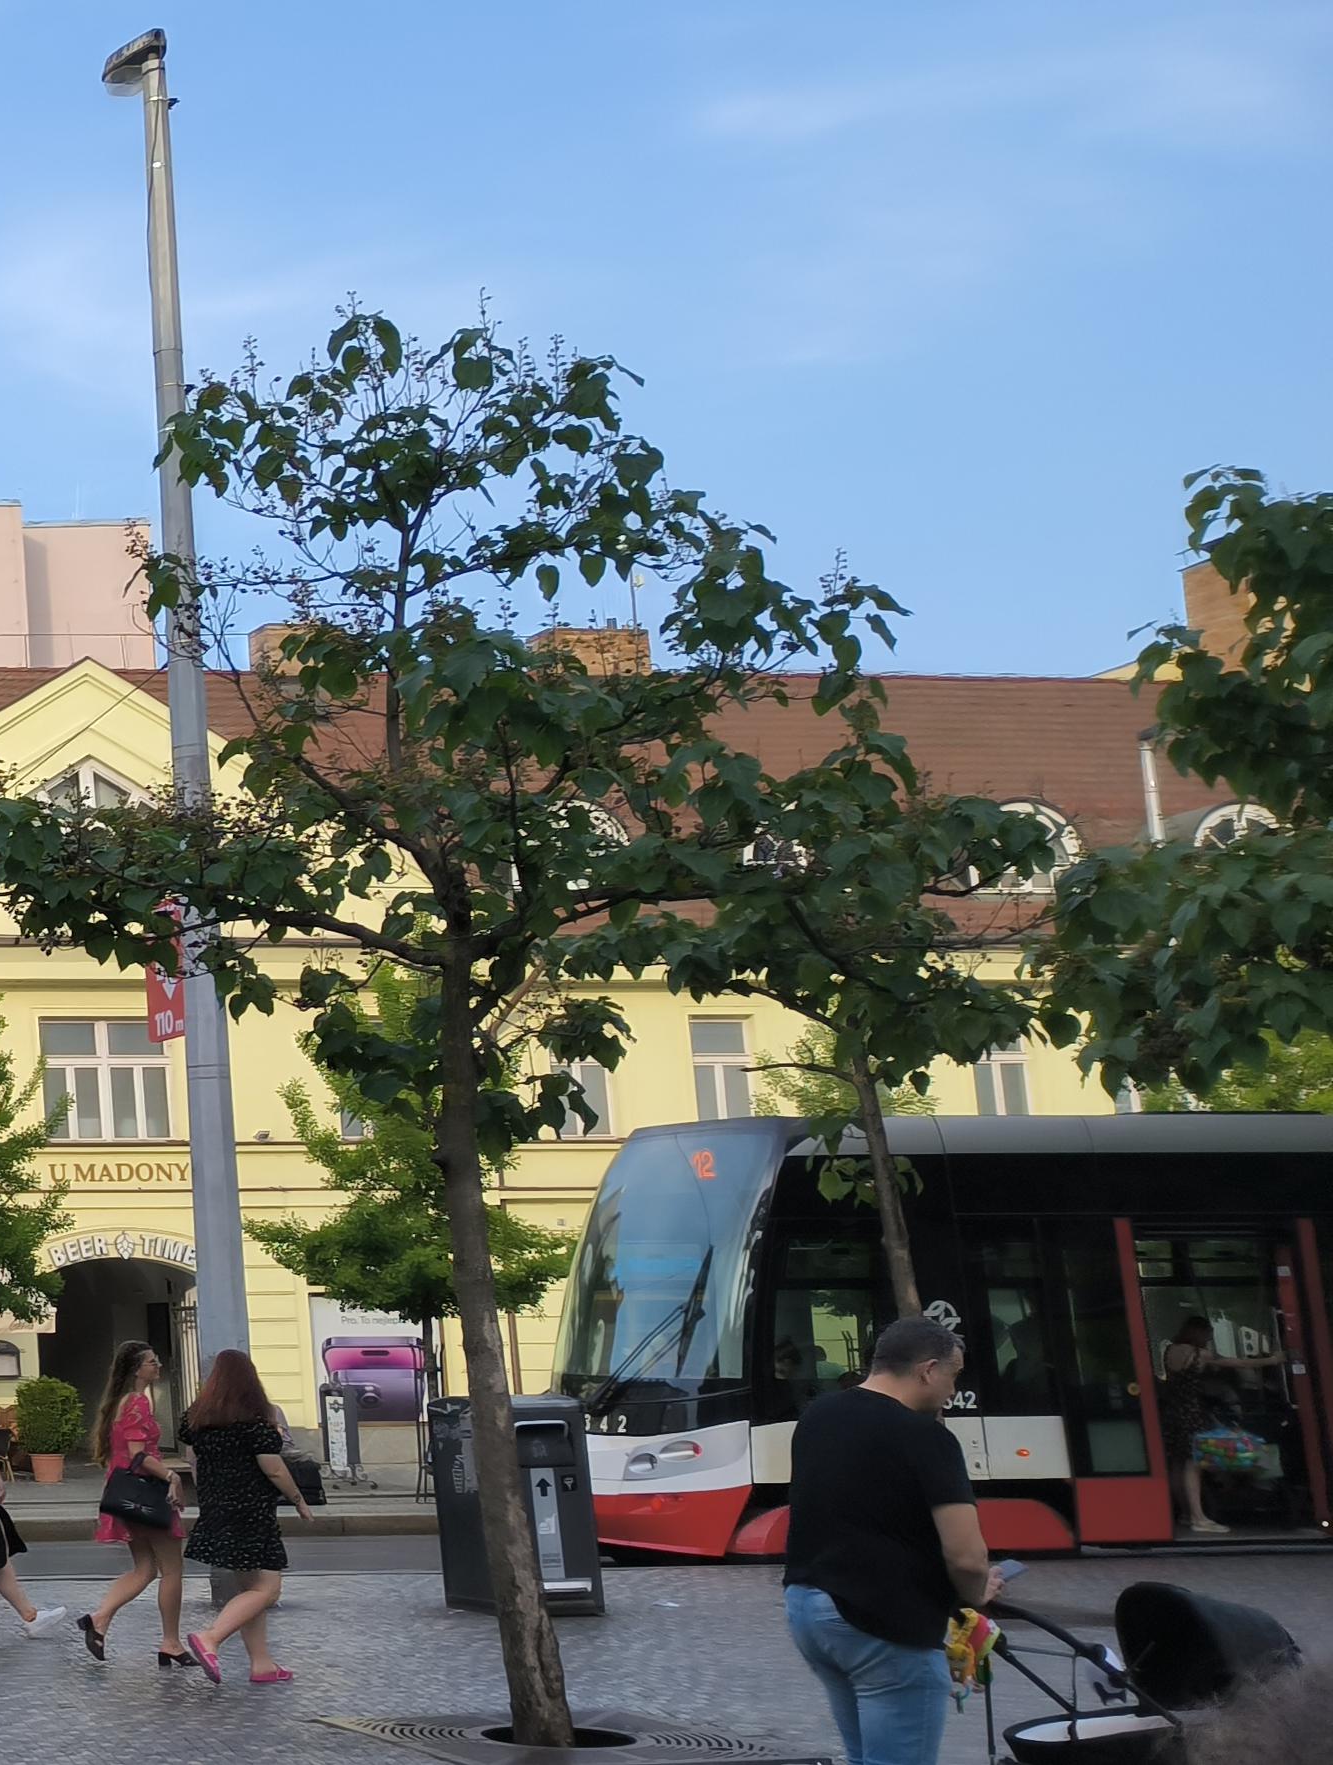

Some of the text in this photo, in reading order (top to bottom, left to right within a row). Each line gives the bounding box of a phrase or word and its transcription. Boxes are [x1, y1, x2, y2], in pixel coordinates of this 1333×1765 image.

[154, 1009, 174, 1037] 110
[48, 1162, 190, 1184] U MADONY
[692, 1151, 716, 1180] 12
[47, 1233, 197, 1268] BEER TIME
[583, 1413, 627, 1433] 342
